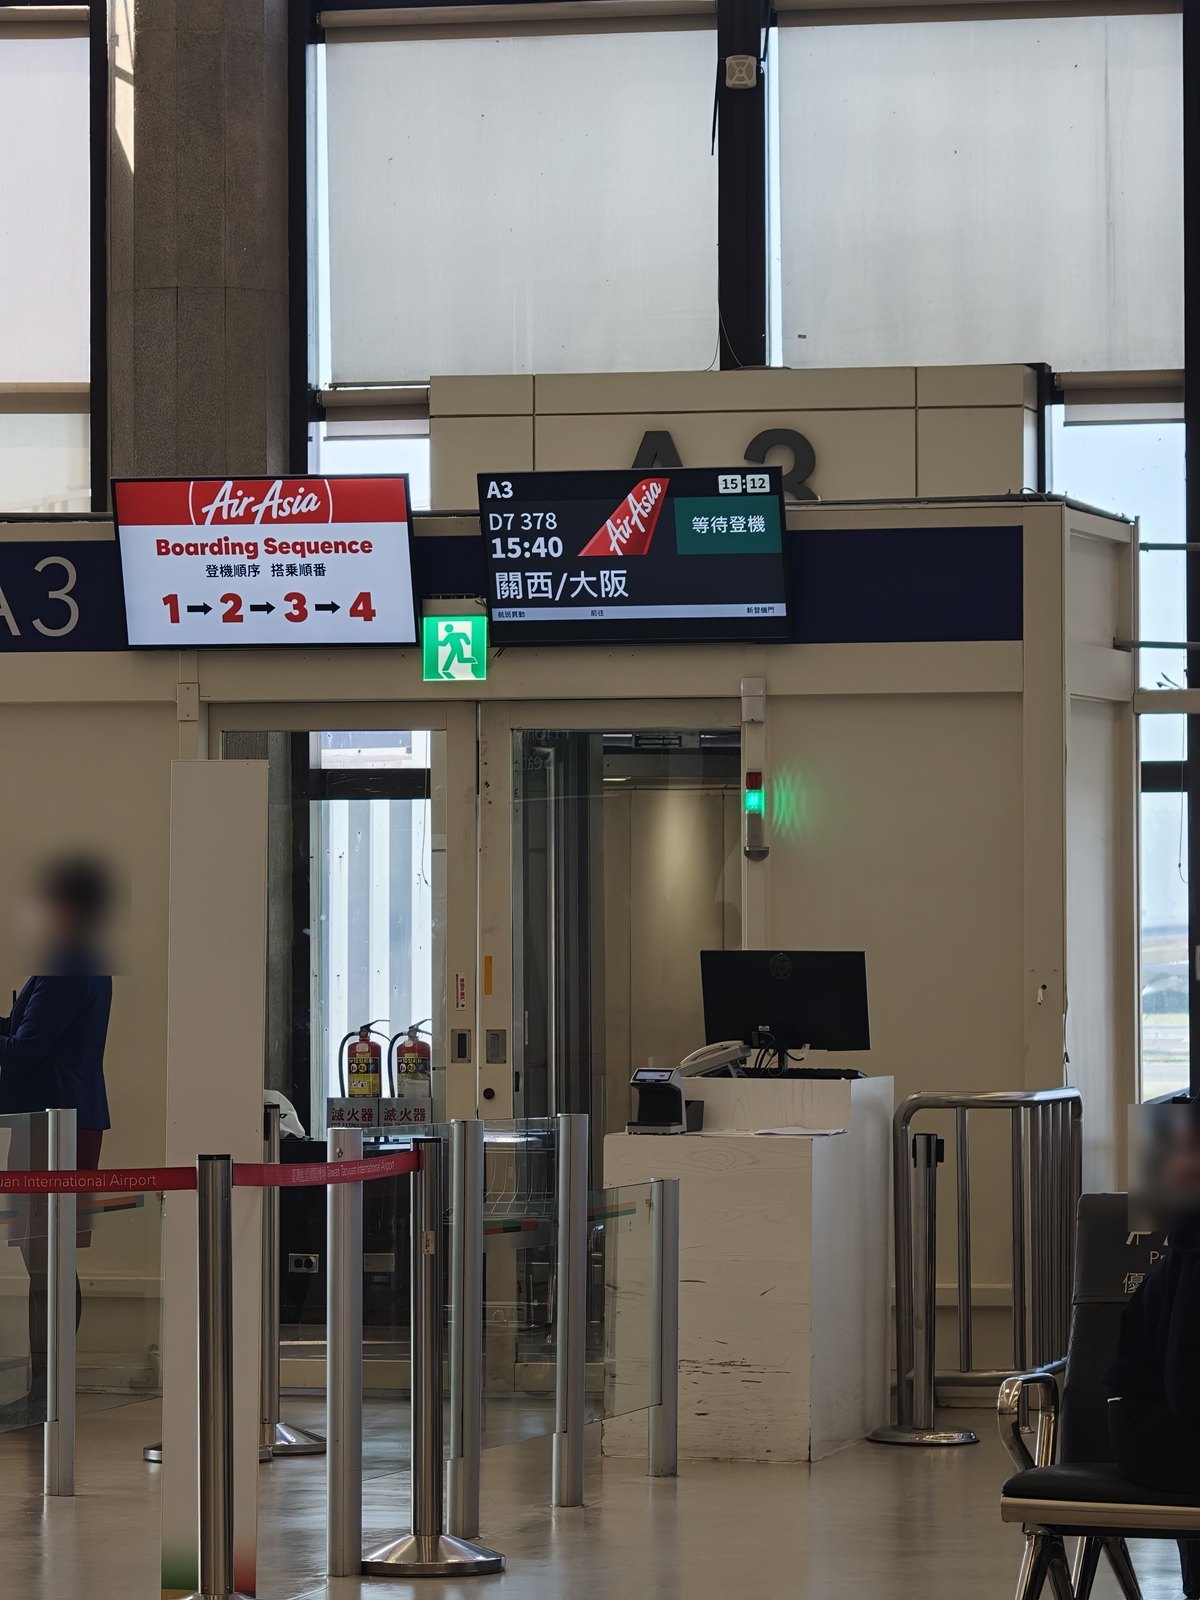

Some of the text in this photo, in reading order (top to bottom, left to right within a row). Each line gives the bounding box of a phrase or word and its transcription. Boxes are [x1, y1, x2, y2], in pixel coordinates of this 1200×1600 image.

[486, 481, 514, 499] A3
[722, 478, 766, 490] 15:12
[489, 512, 557, 531] D7 378
[691, 515, 766, 534] 等待登機
[155, 536, 373, 560] Boarding Sequence
[491, 536, 563, 559] 15:40
[205, 563, 327, 578] 登機順序 搭乗順番
[495, 570, 629, 601] 關西/大阪
[162, 591, 376, 623] 1 2 3 4
[331, 1107, 374, 1122] 滅火器
[384, 1107, 427, 1122] 滅火器
[24, 1174, 107, 1188] International
[109, 1174, 157, 1190] Airport
